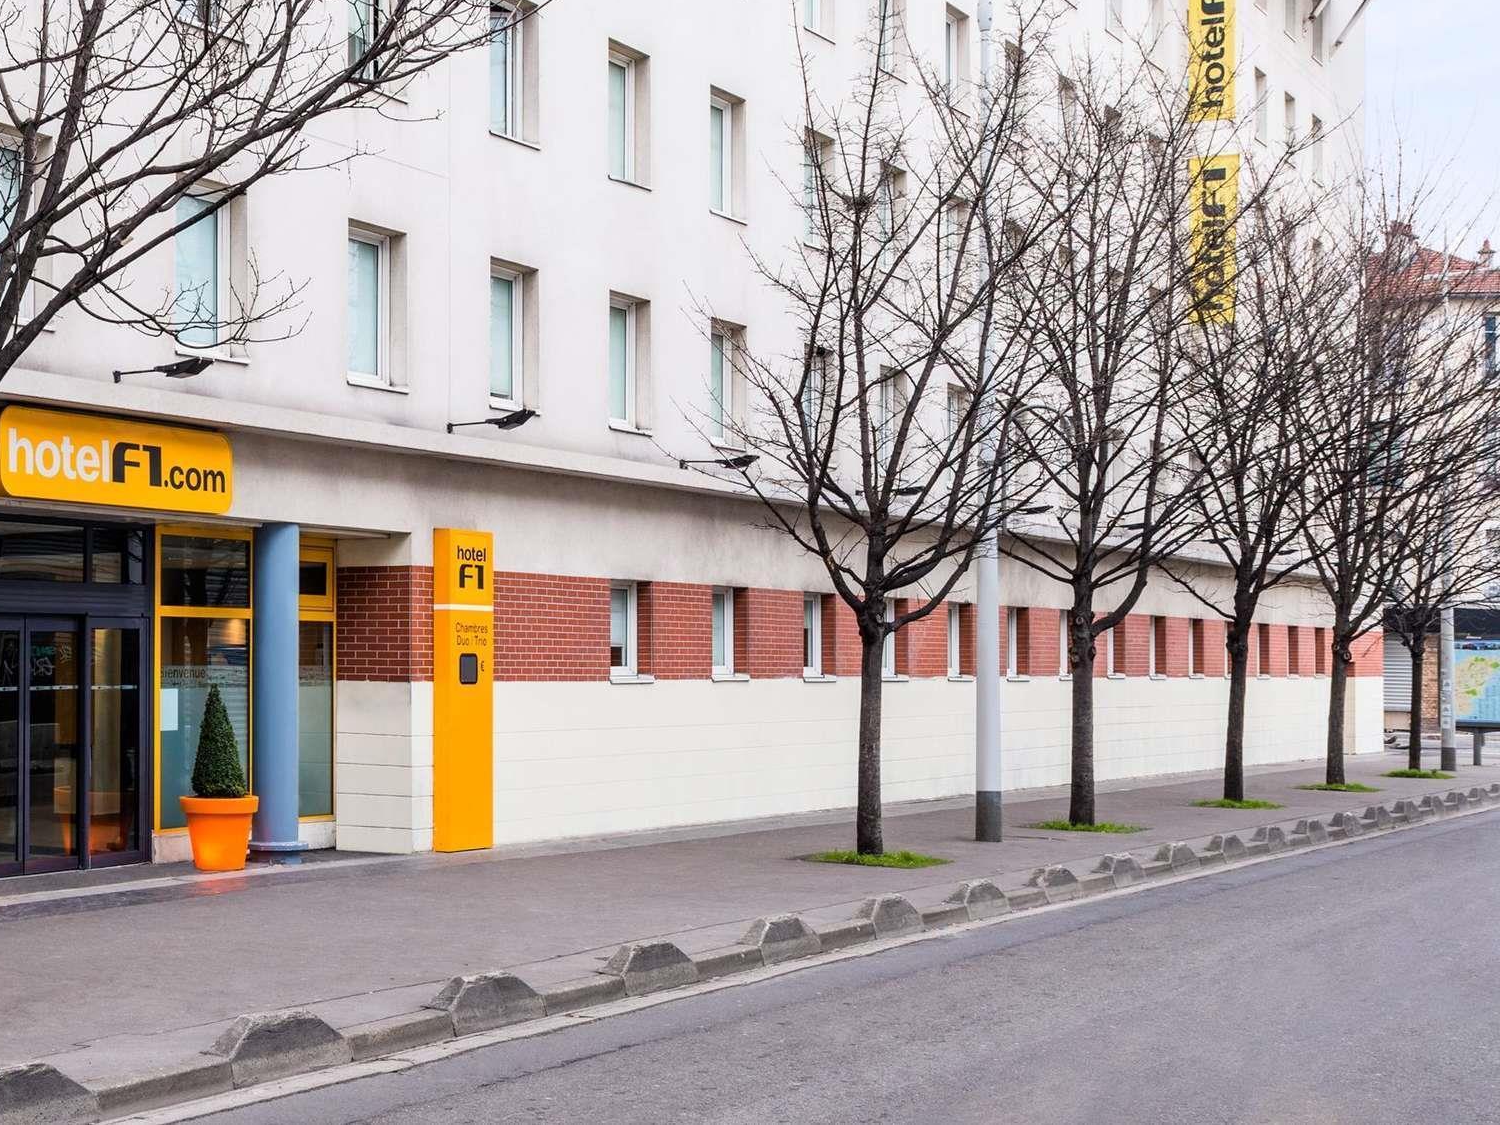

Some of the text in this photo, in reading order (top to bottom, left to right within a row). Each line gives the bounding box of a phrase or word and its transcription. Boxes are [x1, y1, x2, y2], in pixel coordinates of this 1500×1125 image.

[7, 427, 226, 493] hotelF1.com
[457, 545, 486, 562] hotel
[458, 563, 484, 589] F1
[455, 622, 488, 634] Chambres
[456, 635, 469, 646] Duo
[474, 635, 487, 646] Trio
